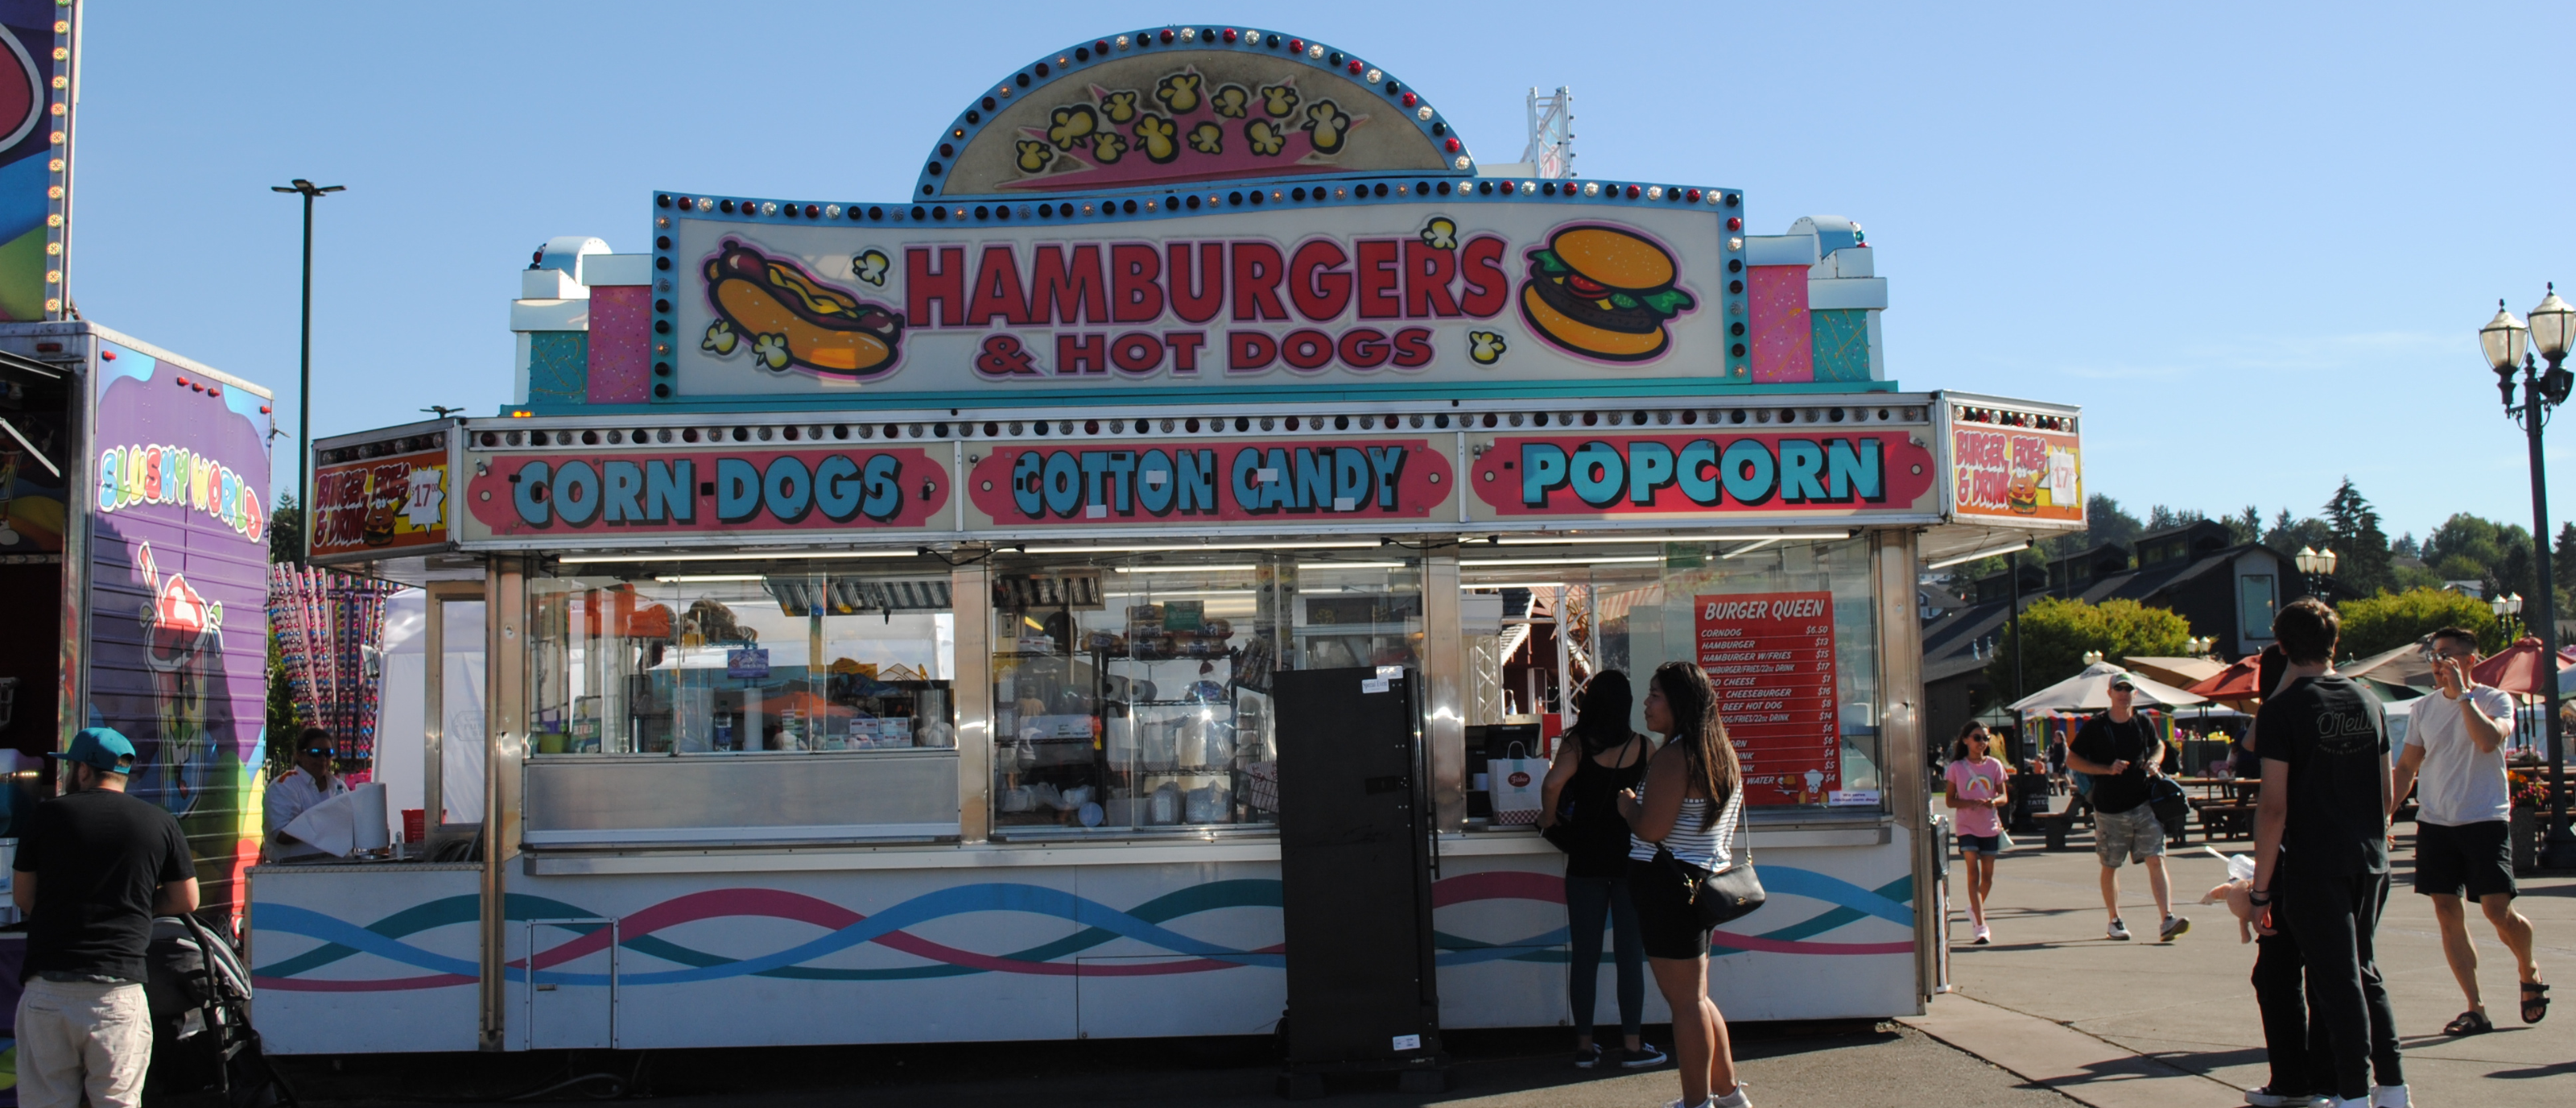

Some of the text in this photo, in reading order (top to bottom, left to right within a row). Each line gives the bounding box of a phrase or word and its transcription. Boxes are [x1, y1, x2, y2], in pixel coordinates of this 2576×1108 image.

[903, 236, 1510, 329] HAMBURGERS
[975, 327, 1435, 376] & HOT DOGS
[2012, 435, 2047, 473] FRIES
[1521, 438, 1885, 509] POPCORN
[370, 462, 412, 505] FRIES
[1012, 446, 1408, 519] COTTON CANDY
[1957, 467, 2011, 510] & DRINK
[99, 444, 264, 543] SLUSHY WORLD
[513, 453, 904, 529] CORN DOGS
[313, 509, 369, 548] & DRINK
[1704, 599, 1825, 621] BURGER QUEEN
[1701, 626, 1828, 638] CORNDOG $6.50
[1701, 638, 1829, 650] HAMBURGER $13
[1702, 650, 1829, 662] HAMBURGER W/FRIES $15
[1775, 664, 1795, 672] DRINK
[1816, 663, 1831, 672] $17
[1724, 677, 1756, 685] CHEESE
[1822, 675, 1831, 684] $1
[1726, 688, 1792, 698] CHEESEBURGER
[1818, 687, 1831, 697] $16
[1723, 700, 1831, 711] BEEF HOT DOG $8
[1769, 713, 1790, 721] DRINK
[1819, 712, 1832, 721] $14
[1823, 724, 1833, 734] $6
[2316, 710, 2374, 736] O'Neill
[1823, 737, 1834, 746] $6
[1824, 749, 1835, 759] $4
[1824, 761, 1835, 771] $5
[1510, 775, 1528, 784] Fisher
[1747, 776, 1775, 784] WATER
[1825, 773, 1836, 783] $4
